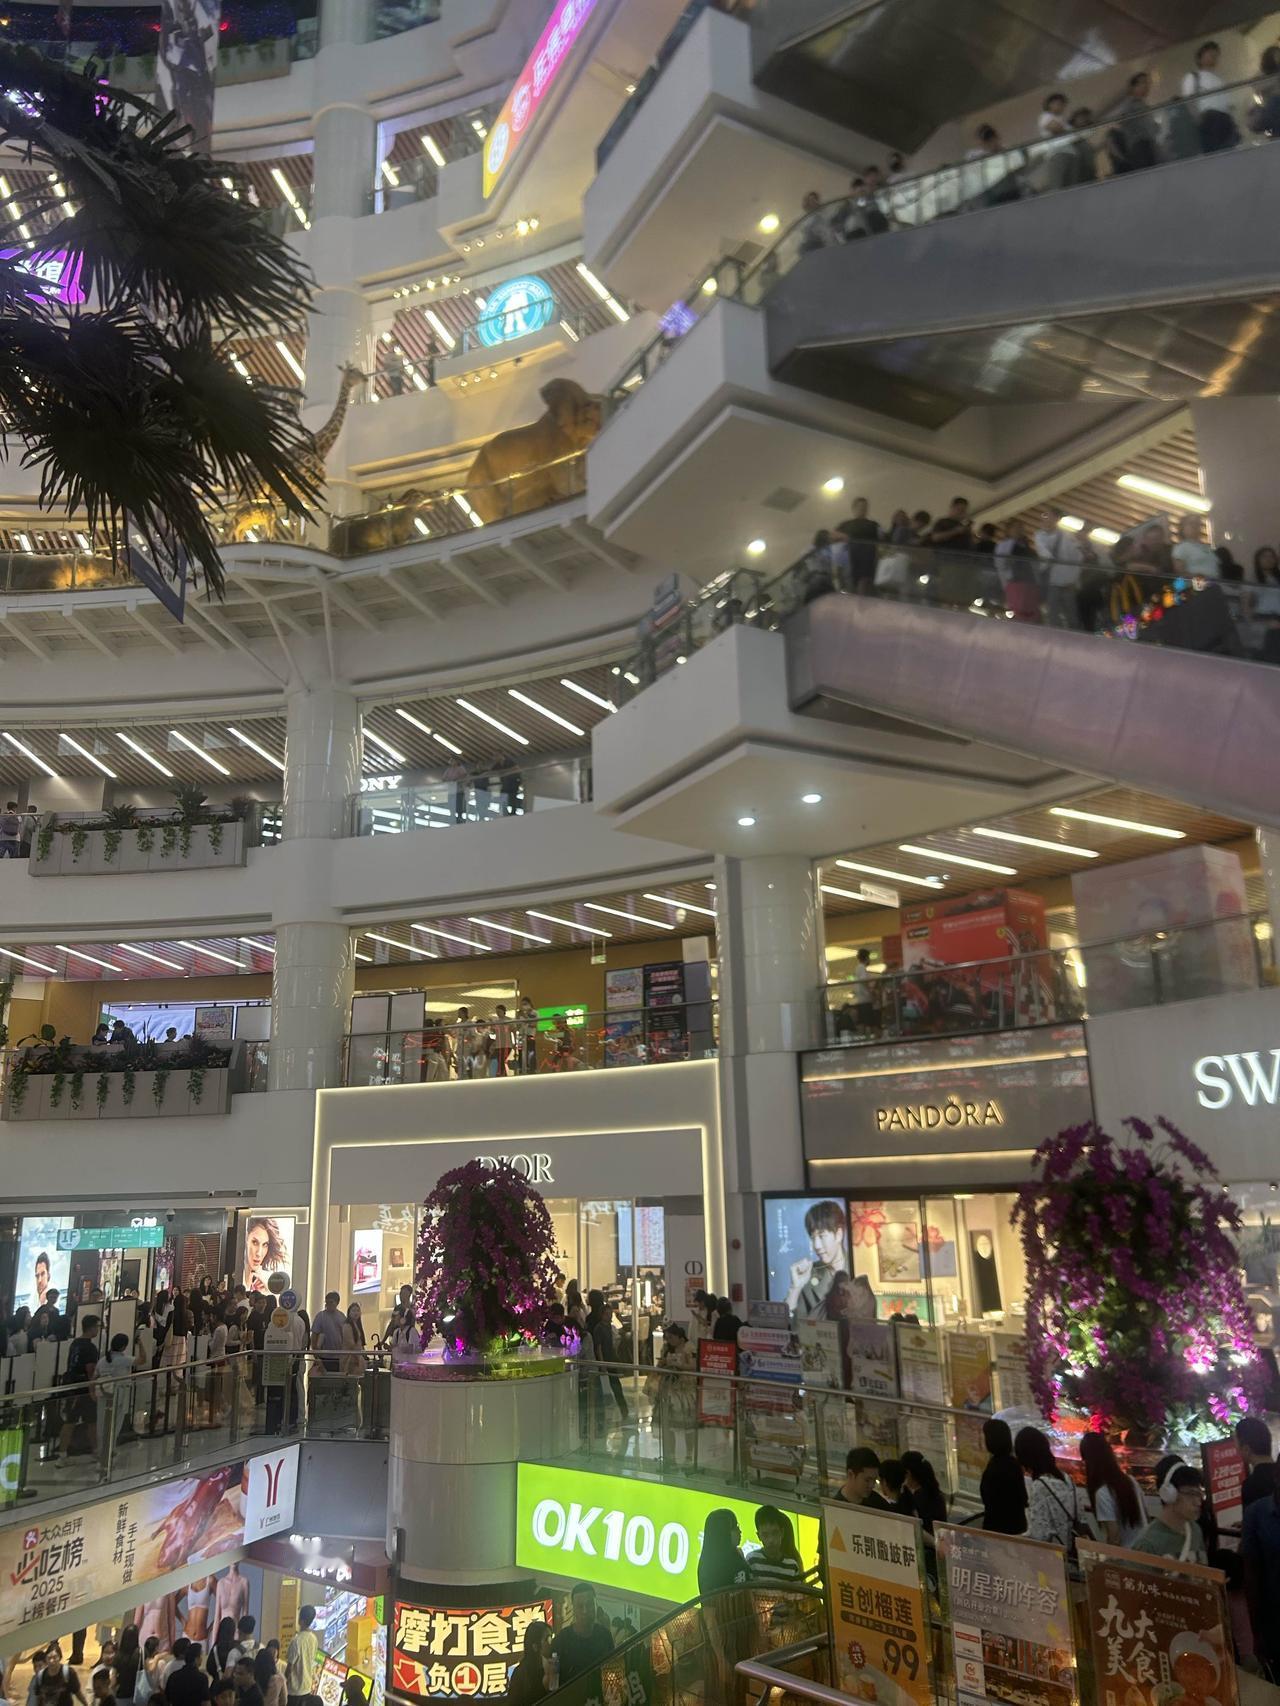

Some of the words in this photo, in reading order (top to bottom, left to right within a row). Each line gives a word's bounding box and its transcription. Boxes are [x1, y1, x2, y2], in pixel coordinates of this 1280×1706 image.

[876, 1098, 1004, 1131] PANDORA
[39, 1517, 83, 1544] 大众点评
[113, 1502, 129, 1565] 新鲜食材
[122, 1522, 138, 1584] 手工现做
[532, 1498, 689, 1575] OK100
[18, 1592, 71, 1625] 上榜餐厅
[30, 1575, 64, 1601] 2025
[838, 1581, 914, 1627] 首创榴莲
[952, 1566, 1059, 1615] 明星新阵容
